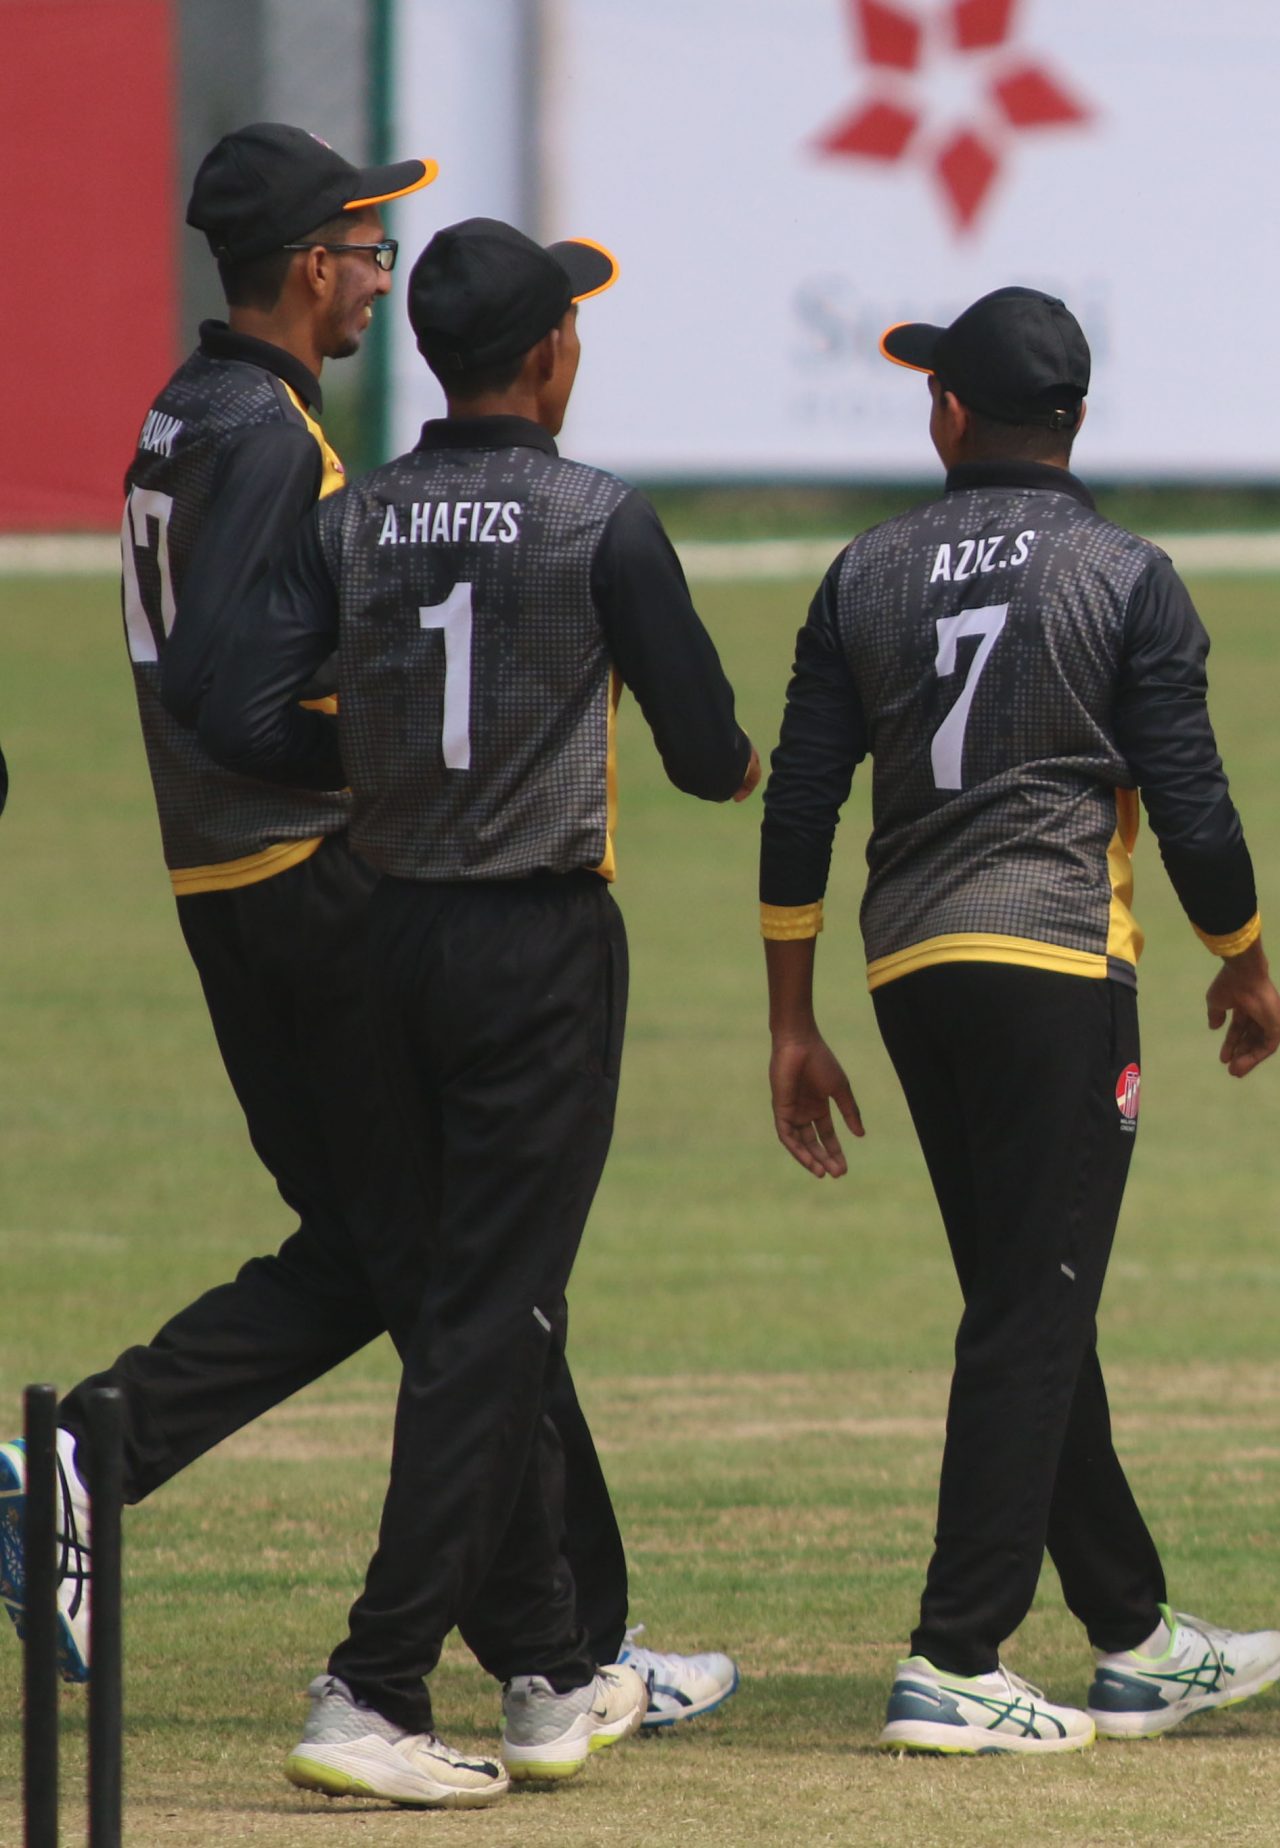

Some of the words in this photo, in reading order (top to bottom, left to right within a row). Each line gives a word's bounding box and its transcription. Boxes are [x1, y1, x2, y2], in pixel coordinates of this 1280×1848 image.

[930, 530, 1035, 583] AZIZ.S
[419, 582, 472, 770] 1
[931, 602, 1009, 790] 7
